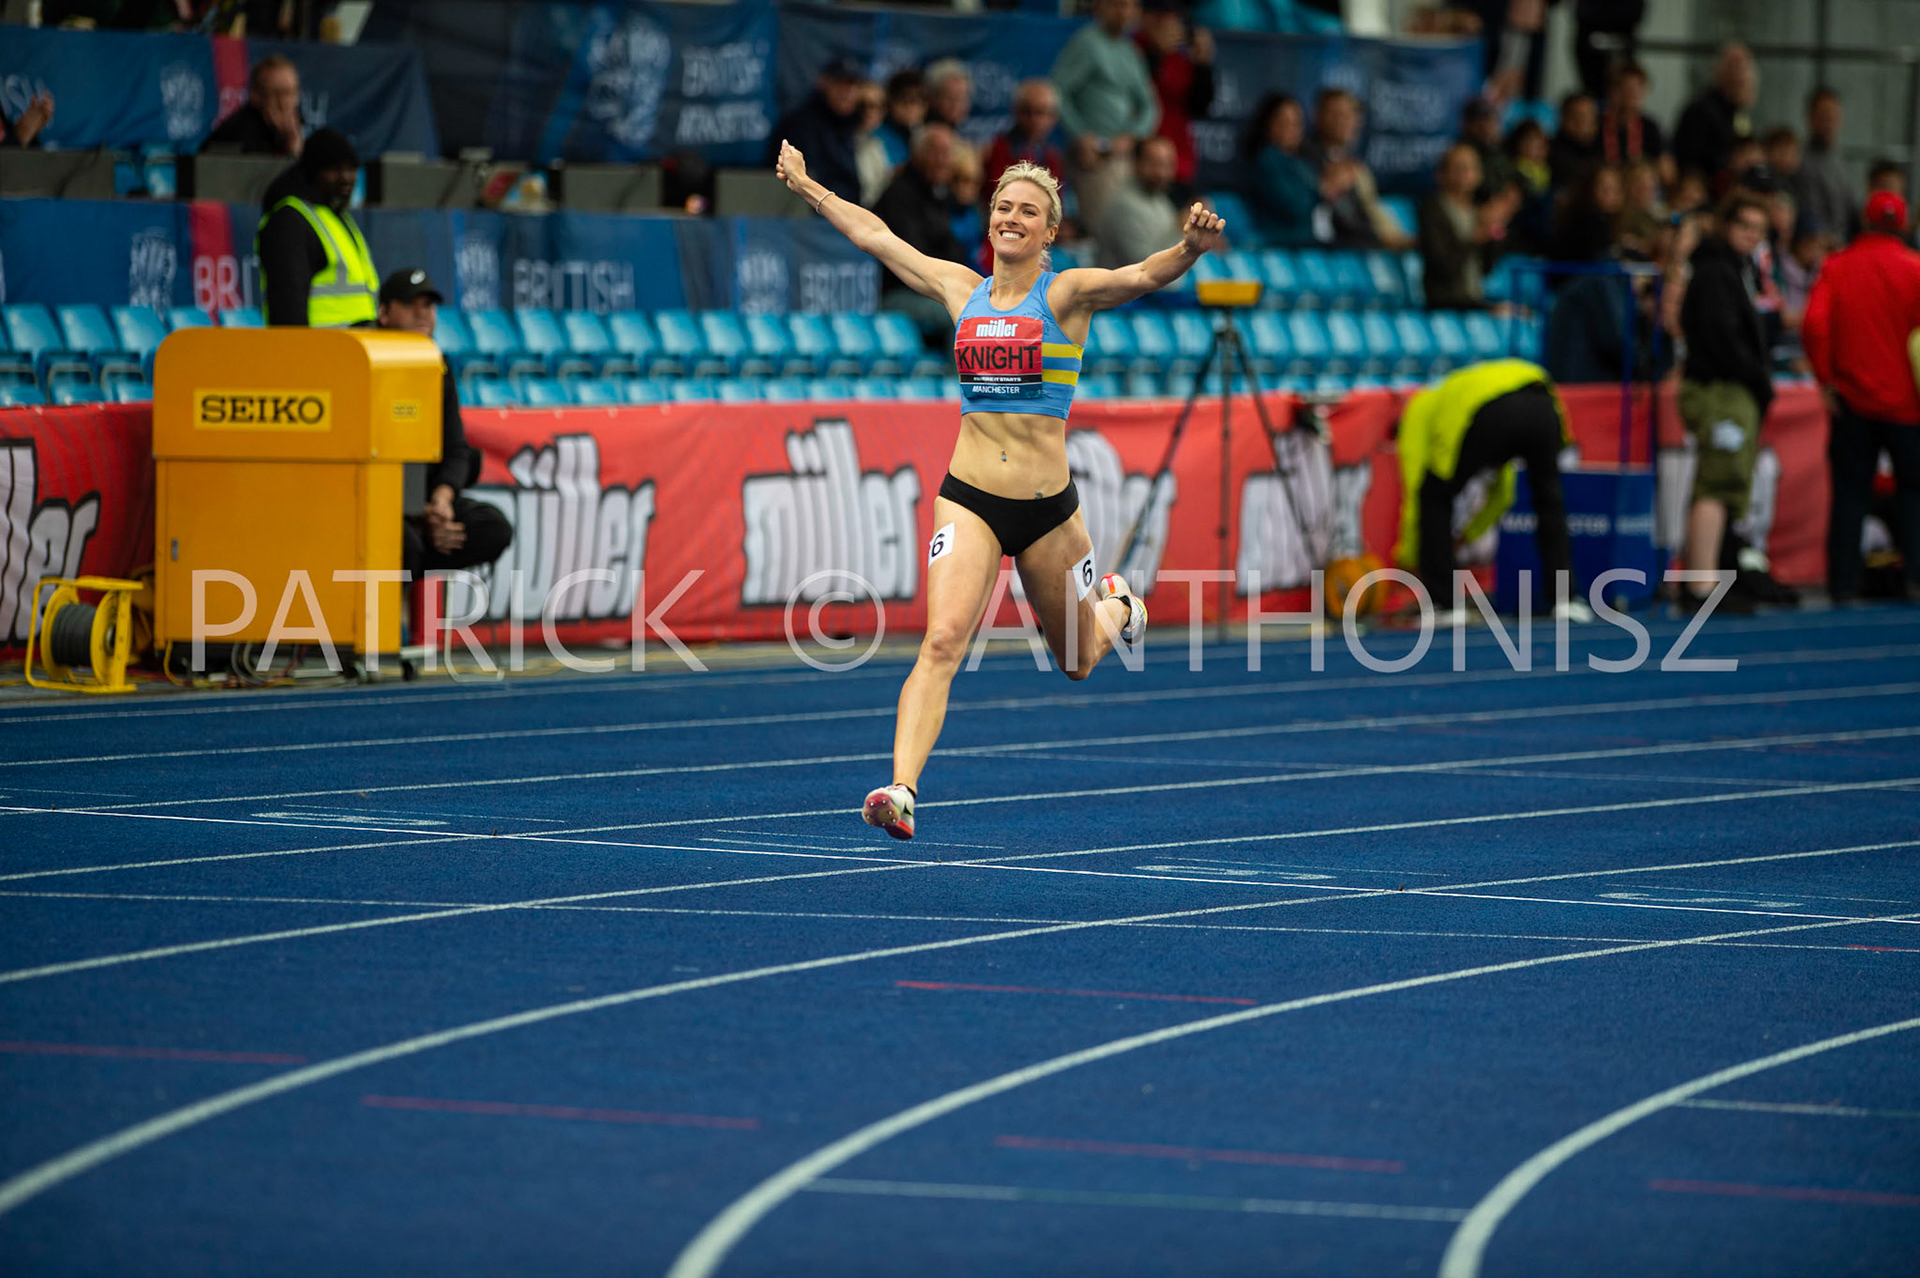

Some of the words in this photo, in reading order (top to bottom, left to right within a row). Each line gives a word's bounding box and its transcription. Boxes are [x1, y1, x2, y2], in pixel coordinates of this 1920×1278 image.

[976, 319, 1018, 338] müller
[957, 345, 1038, 370] KNIGHT
[972, 385, 1020, 394] MANCHESTER
[200, 394, 325, 424] SEIKO
[930, 532, 945, 557] 6
[1082, 559, 1093, 587] 6
